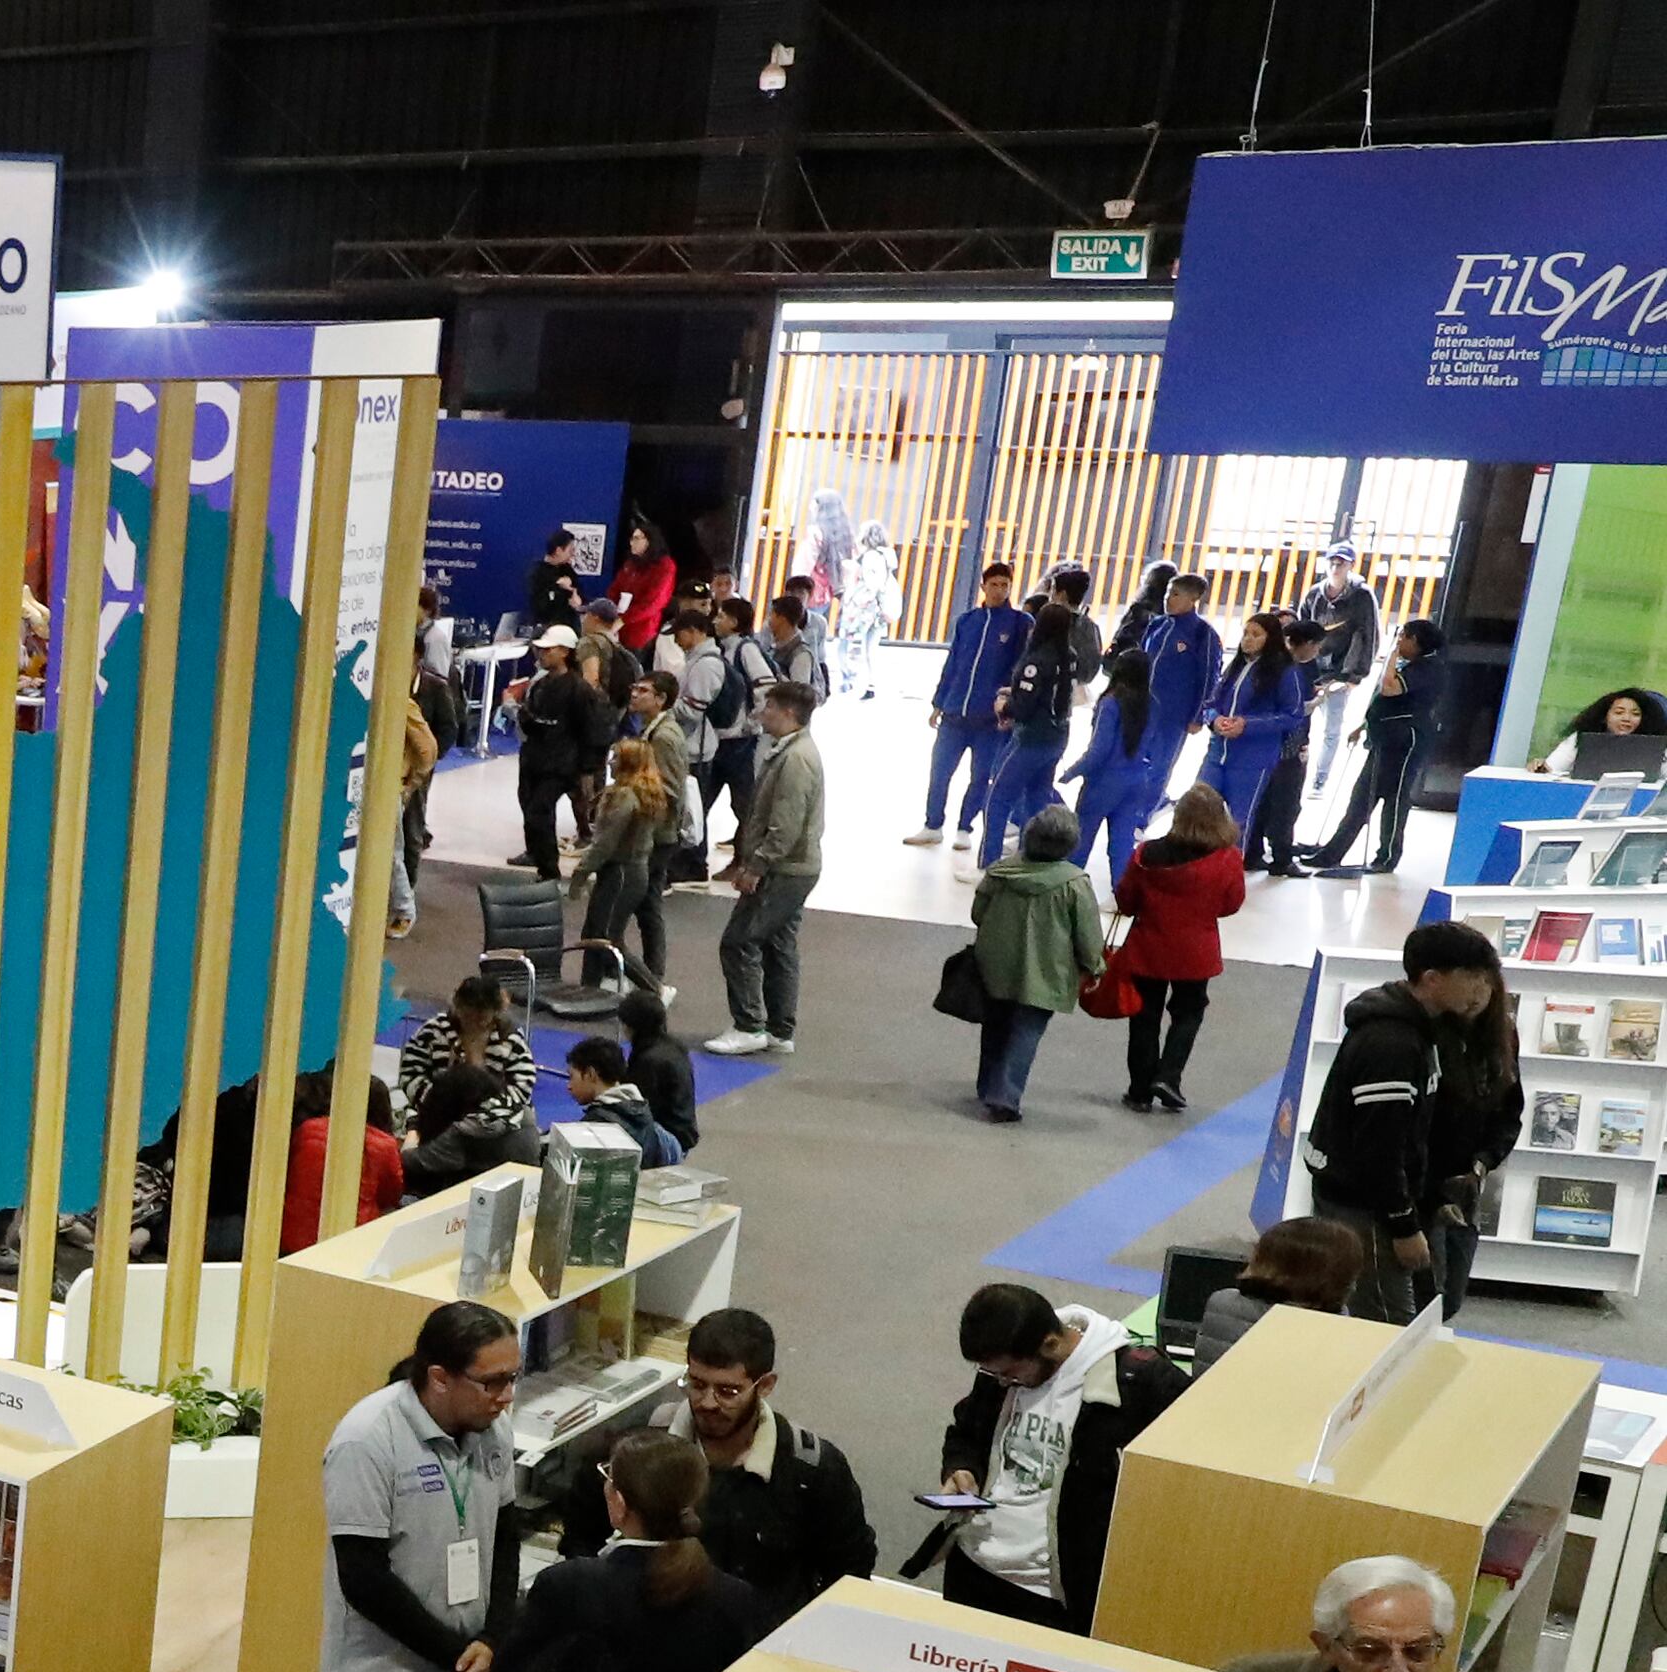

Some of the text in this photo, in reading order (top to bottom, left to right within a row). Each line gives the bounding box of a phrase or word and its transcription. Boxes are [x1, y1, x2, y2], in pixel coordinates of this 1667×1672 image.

[1059, 239, 1122, 255] SALIDA
[1071, 256, 1109, 272] EXIT
[1436, 323, 1468, 336] Feria
[1434, 335, 1515, 348] Internacional
[1547, 334, 1611, 350] sumérgete
[1613, 341, 1628, 351] en
[1431, 349, 1540, 362] del Libro, las Artes
[1429, 362, 1499, 375] y la Cultura
[1426, 374, 1519, 387] de Santa Marta
[355, 394, 398, 425] nex
[431, 470, 504, 491] TADEO
